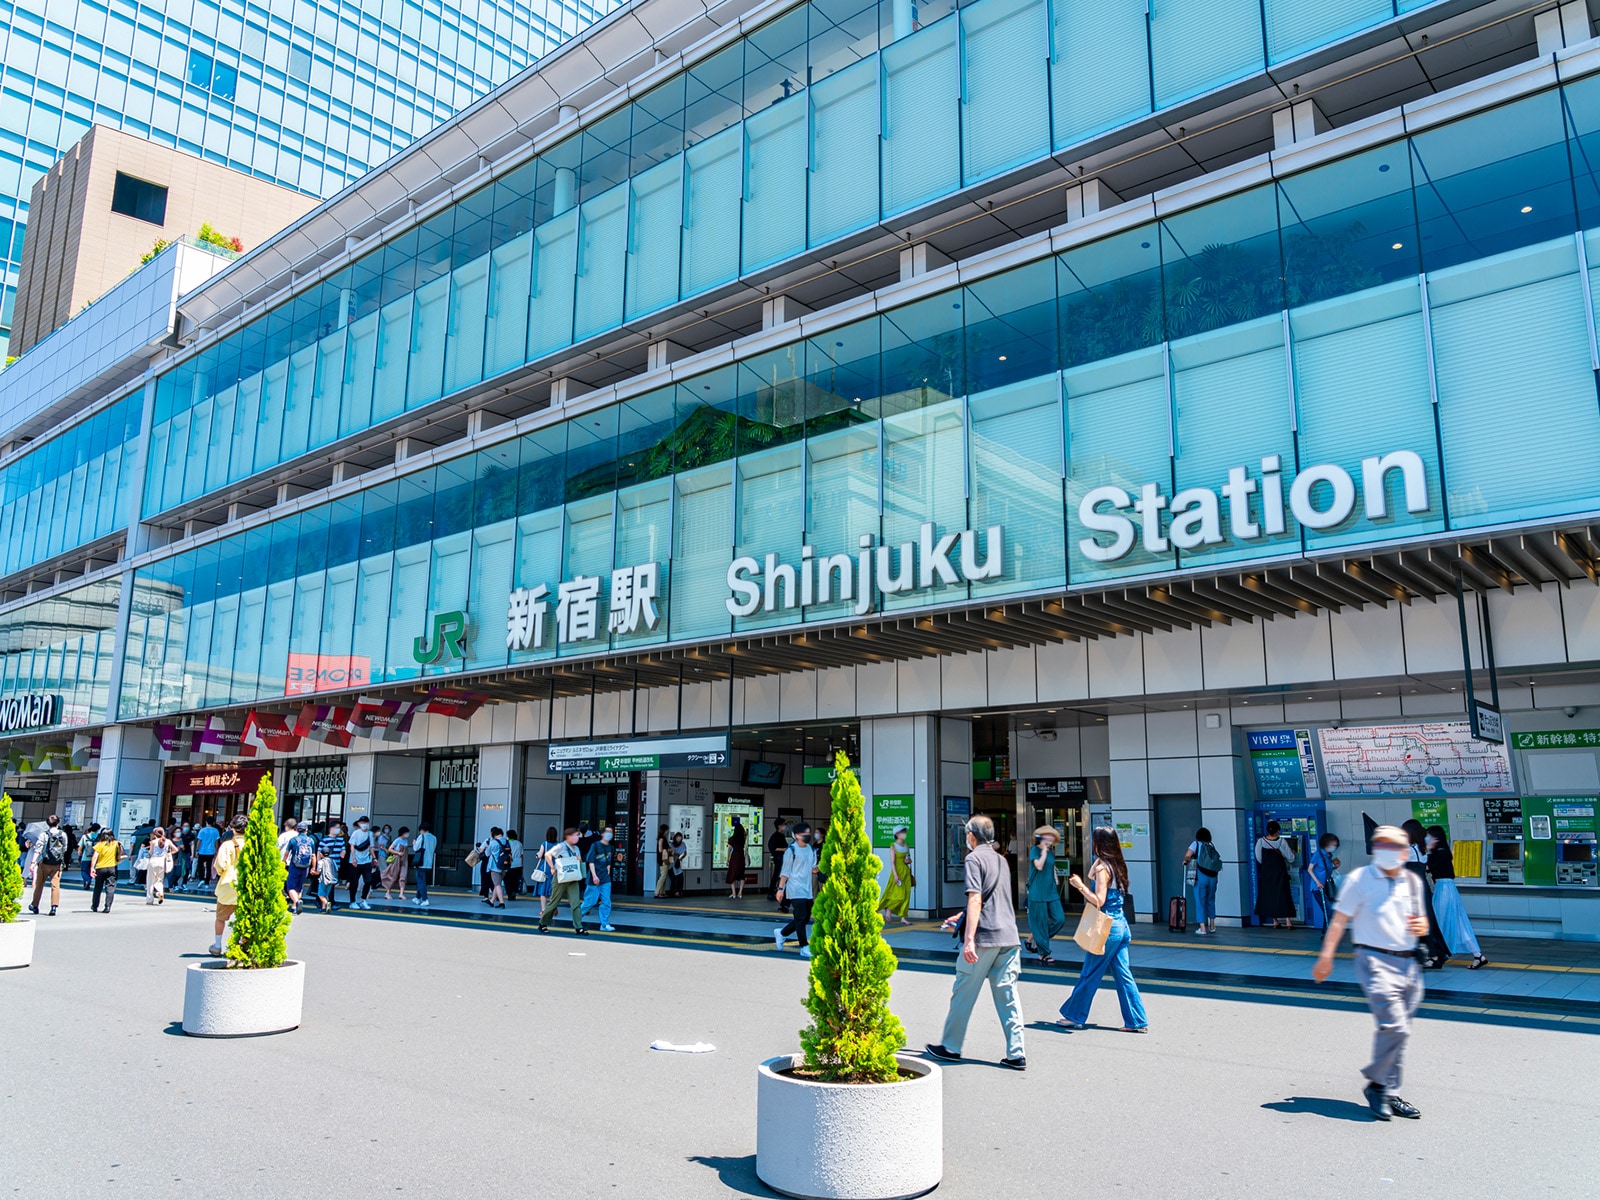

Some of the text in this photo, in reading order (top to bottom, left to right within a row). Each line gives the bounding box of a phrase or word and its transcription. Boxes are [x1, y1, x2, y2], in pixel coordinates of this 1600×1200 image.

[413, 450, 1430, 664] JR 新宿駅 Shinjuku Station
[1536, 732, 1600, 746] 新幹線・特
[611, 758, 620, 766] JR
[308, 770, 346, 789] DEGREES
[879, 799, 889, 807] JR
[1484, 800, 1501, 808] きっぷ
